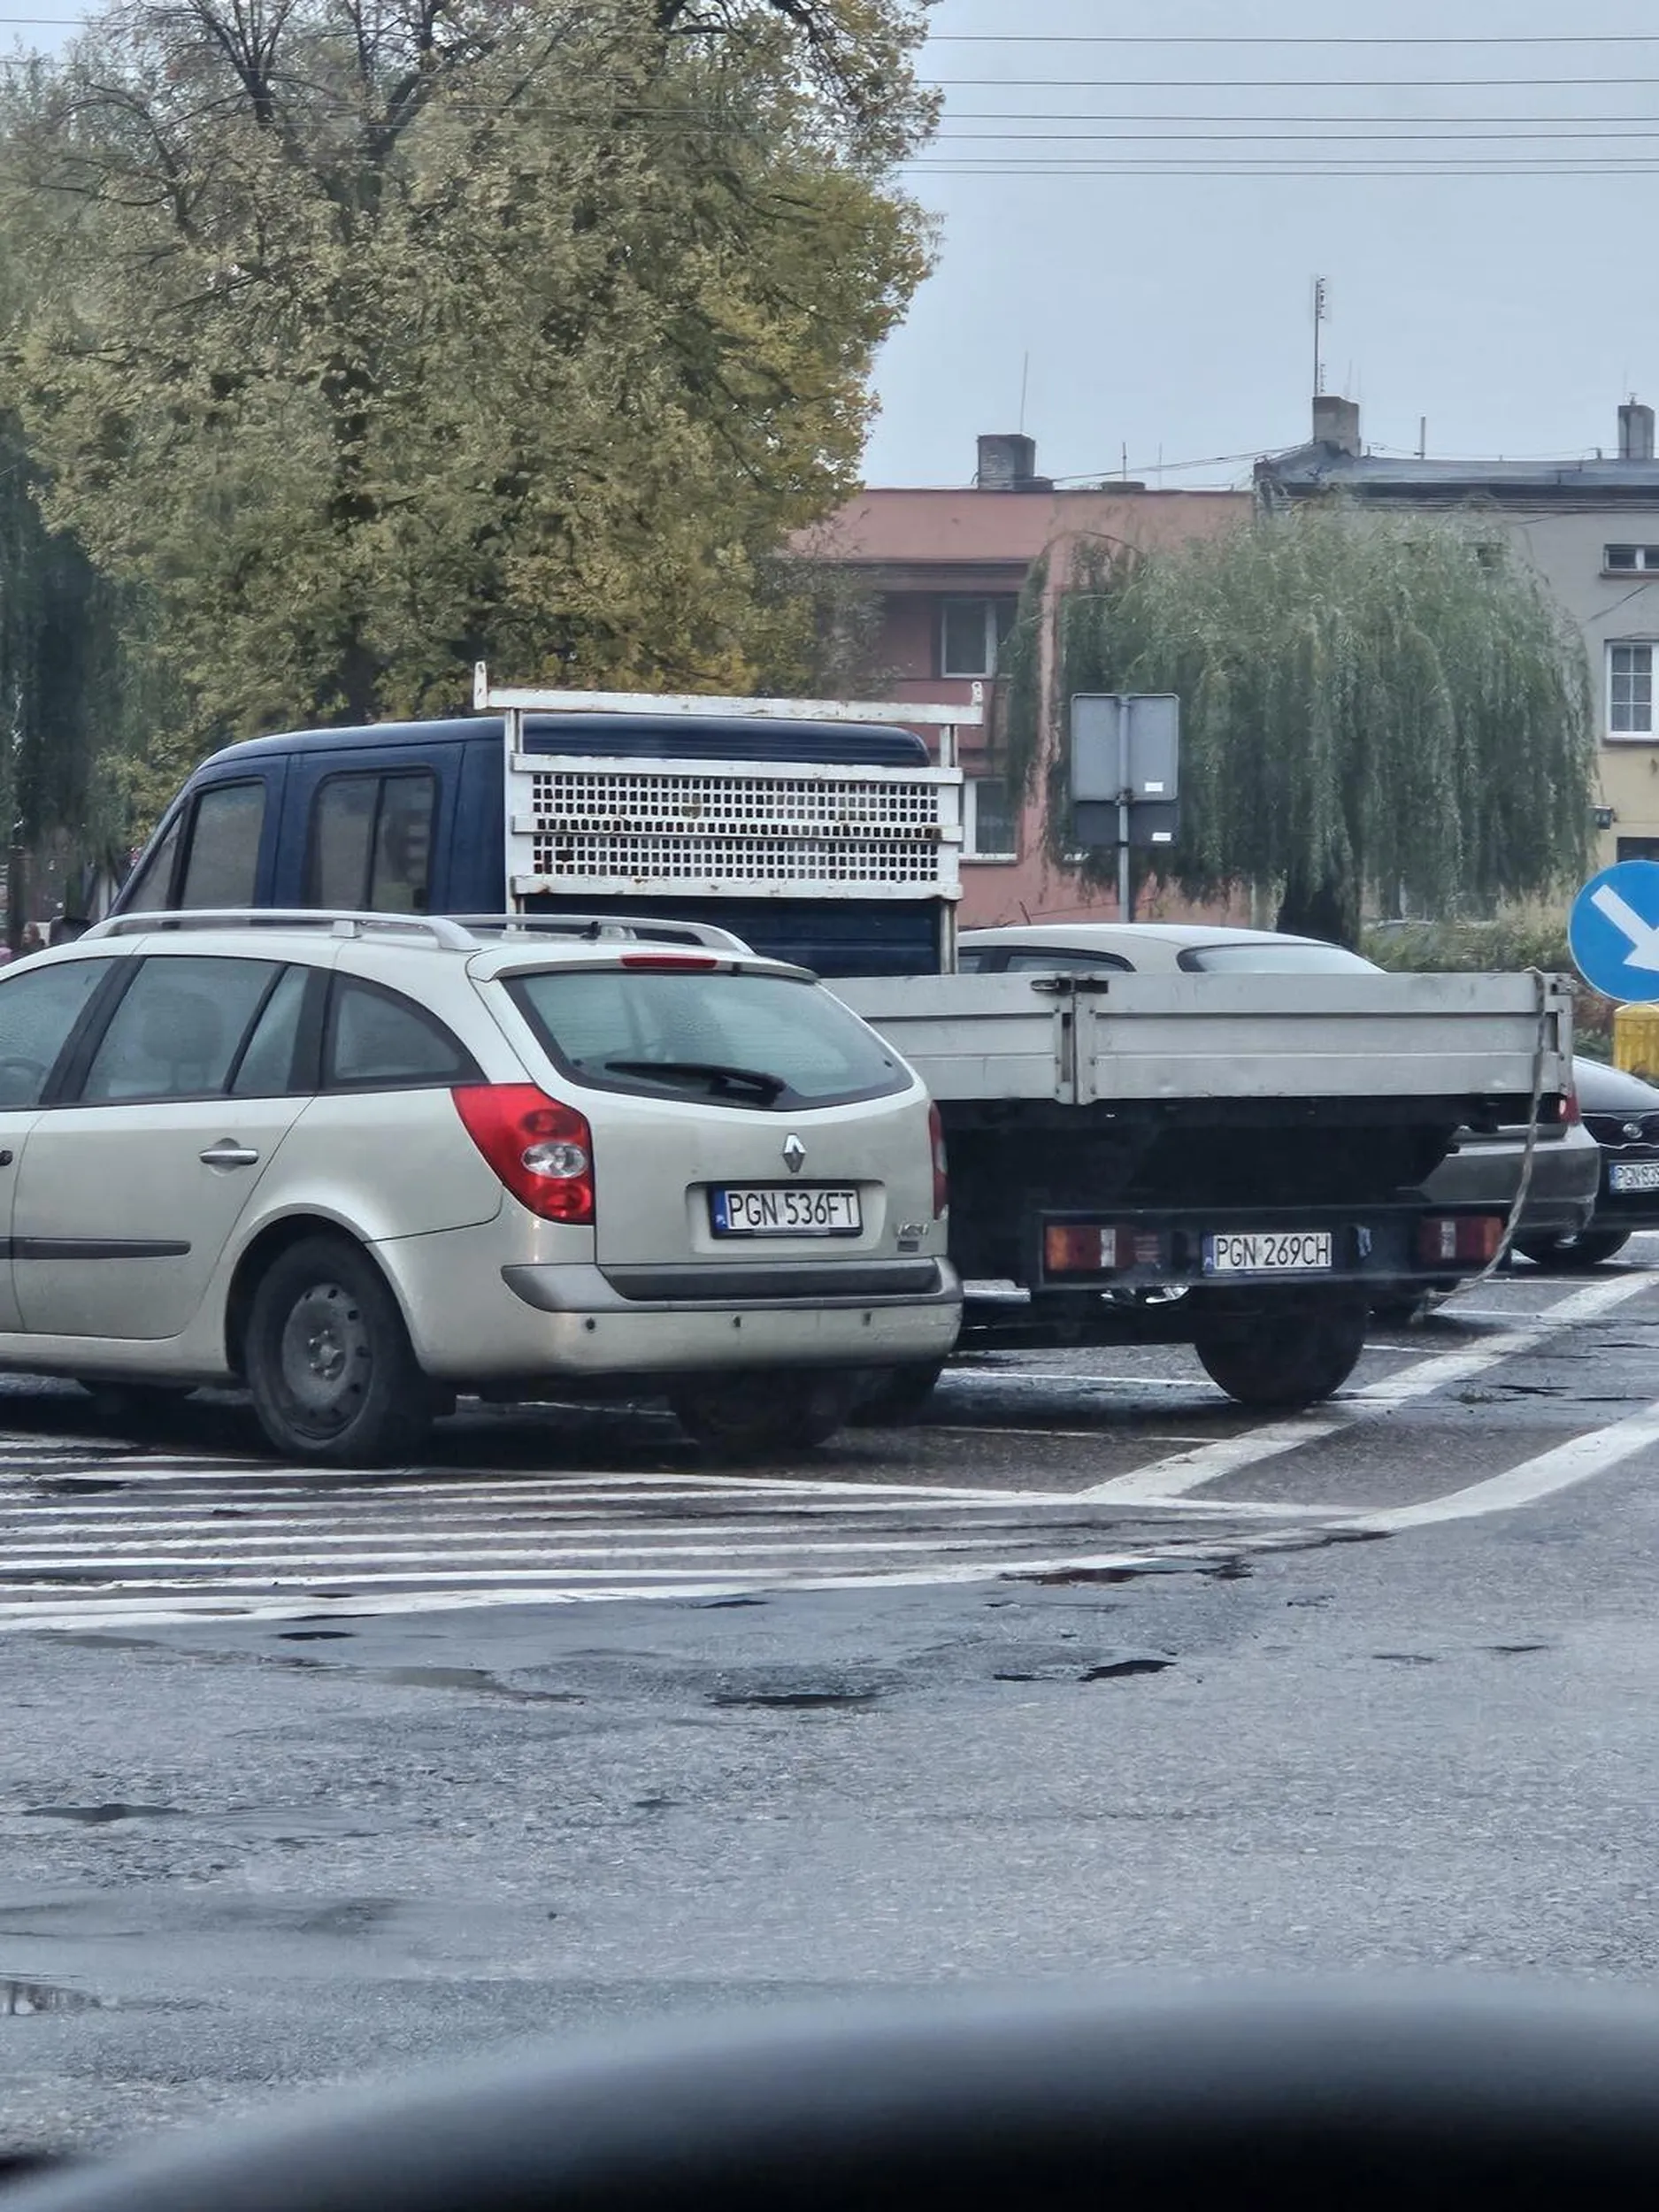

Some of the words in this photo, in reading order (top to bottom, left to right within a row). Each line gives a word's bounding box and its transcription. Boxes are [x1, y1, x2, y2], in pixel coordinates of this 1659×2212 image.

[727, 1193, 779, 1227] PGN
[785, 1192, 855, 1225] 536FT
[1216, 1236, 1256, 1267] PGN
[1263, 1235, 1329, 1266] 269CH
